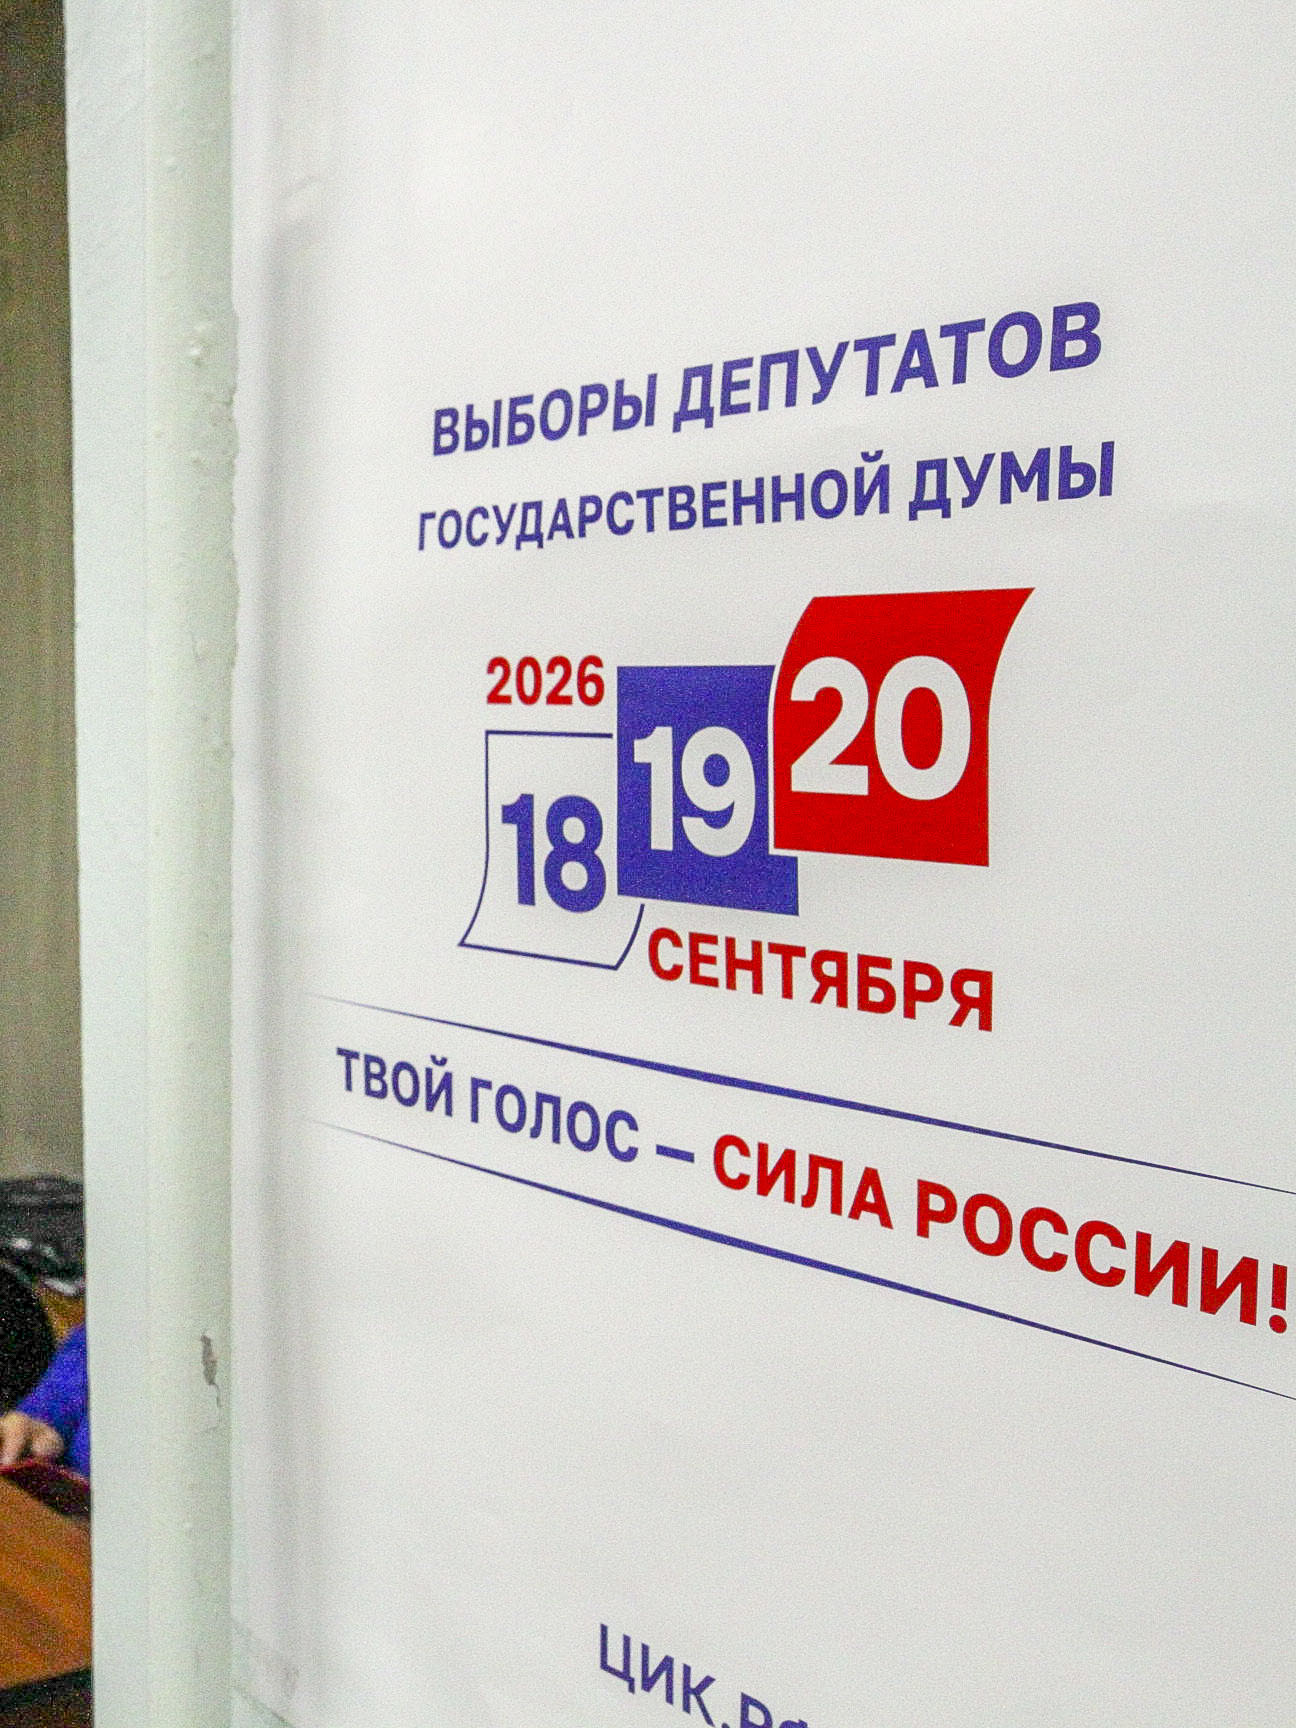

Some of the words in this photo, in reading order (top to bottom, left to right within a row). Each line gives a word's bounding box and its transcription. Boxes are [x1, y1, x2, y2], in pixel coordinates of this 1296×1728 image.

[432, 373, 657, 456] ВЫБОРЫ
[672, 301, 1102, 433] ДЕПУТАТОВ
[418, 450, 891, 551] ГОСУДАРСТВЕННОЙ
[908, 441, 1116, 521] ДУМЫ
[485, 654, 606, 707] 2026
[501, 793, 606, 914] 18
[633, 725, 757, 858] 19
[790, 654, 972, 800] 20
[647, 926, 994, 1032] СЕНТЯБРЯ
[336, 1047, 453, 1116] ТВОЙ
[470, 1077, 639, 1163] ГОЛОС
[712, 1133, 894, 1230] СИЛА
[915, 1178, 1289, 1335] РОССИИ!
[599, 1622, 808, 1728] ЦИК.Р
